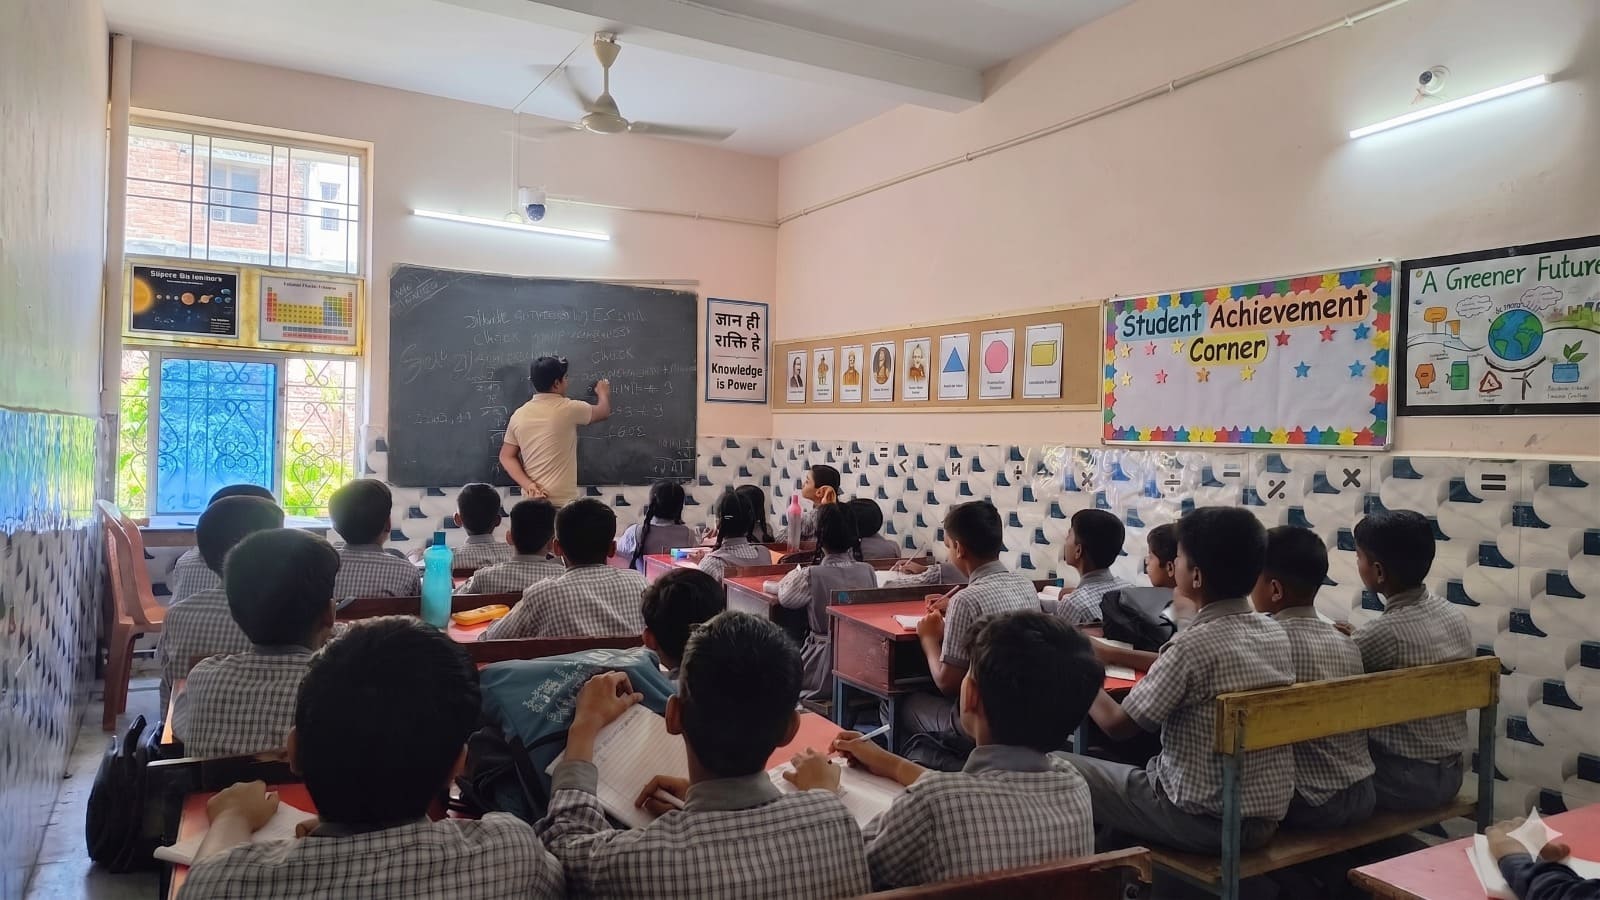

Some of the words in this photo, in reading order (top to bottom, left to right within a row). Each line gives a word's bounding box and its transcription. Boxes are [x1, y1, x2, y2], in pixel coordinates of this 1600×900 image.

[1421, 271, 1438, 294] A
[1446, 267, 1527, 290] Greener
[1537, 254, 1600, 281] Future
[715, 312, 743, 327] जान
[746, 311, 761, 331] ही
[1122, 308, 1202, 338] Student
[1210, 289, 1368, 330] Achievement
[1189, 337, 1266, 362] Corner
[711, 362, 763, 378] Knowledge
[716, 378, 725, 390] is
[727, 378, 758, 391] Power
